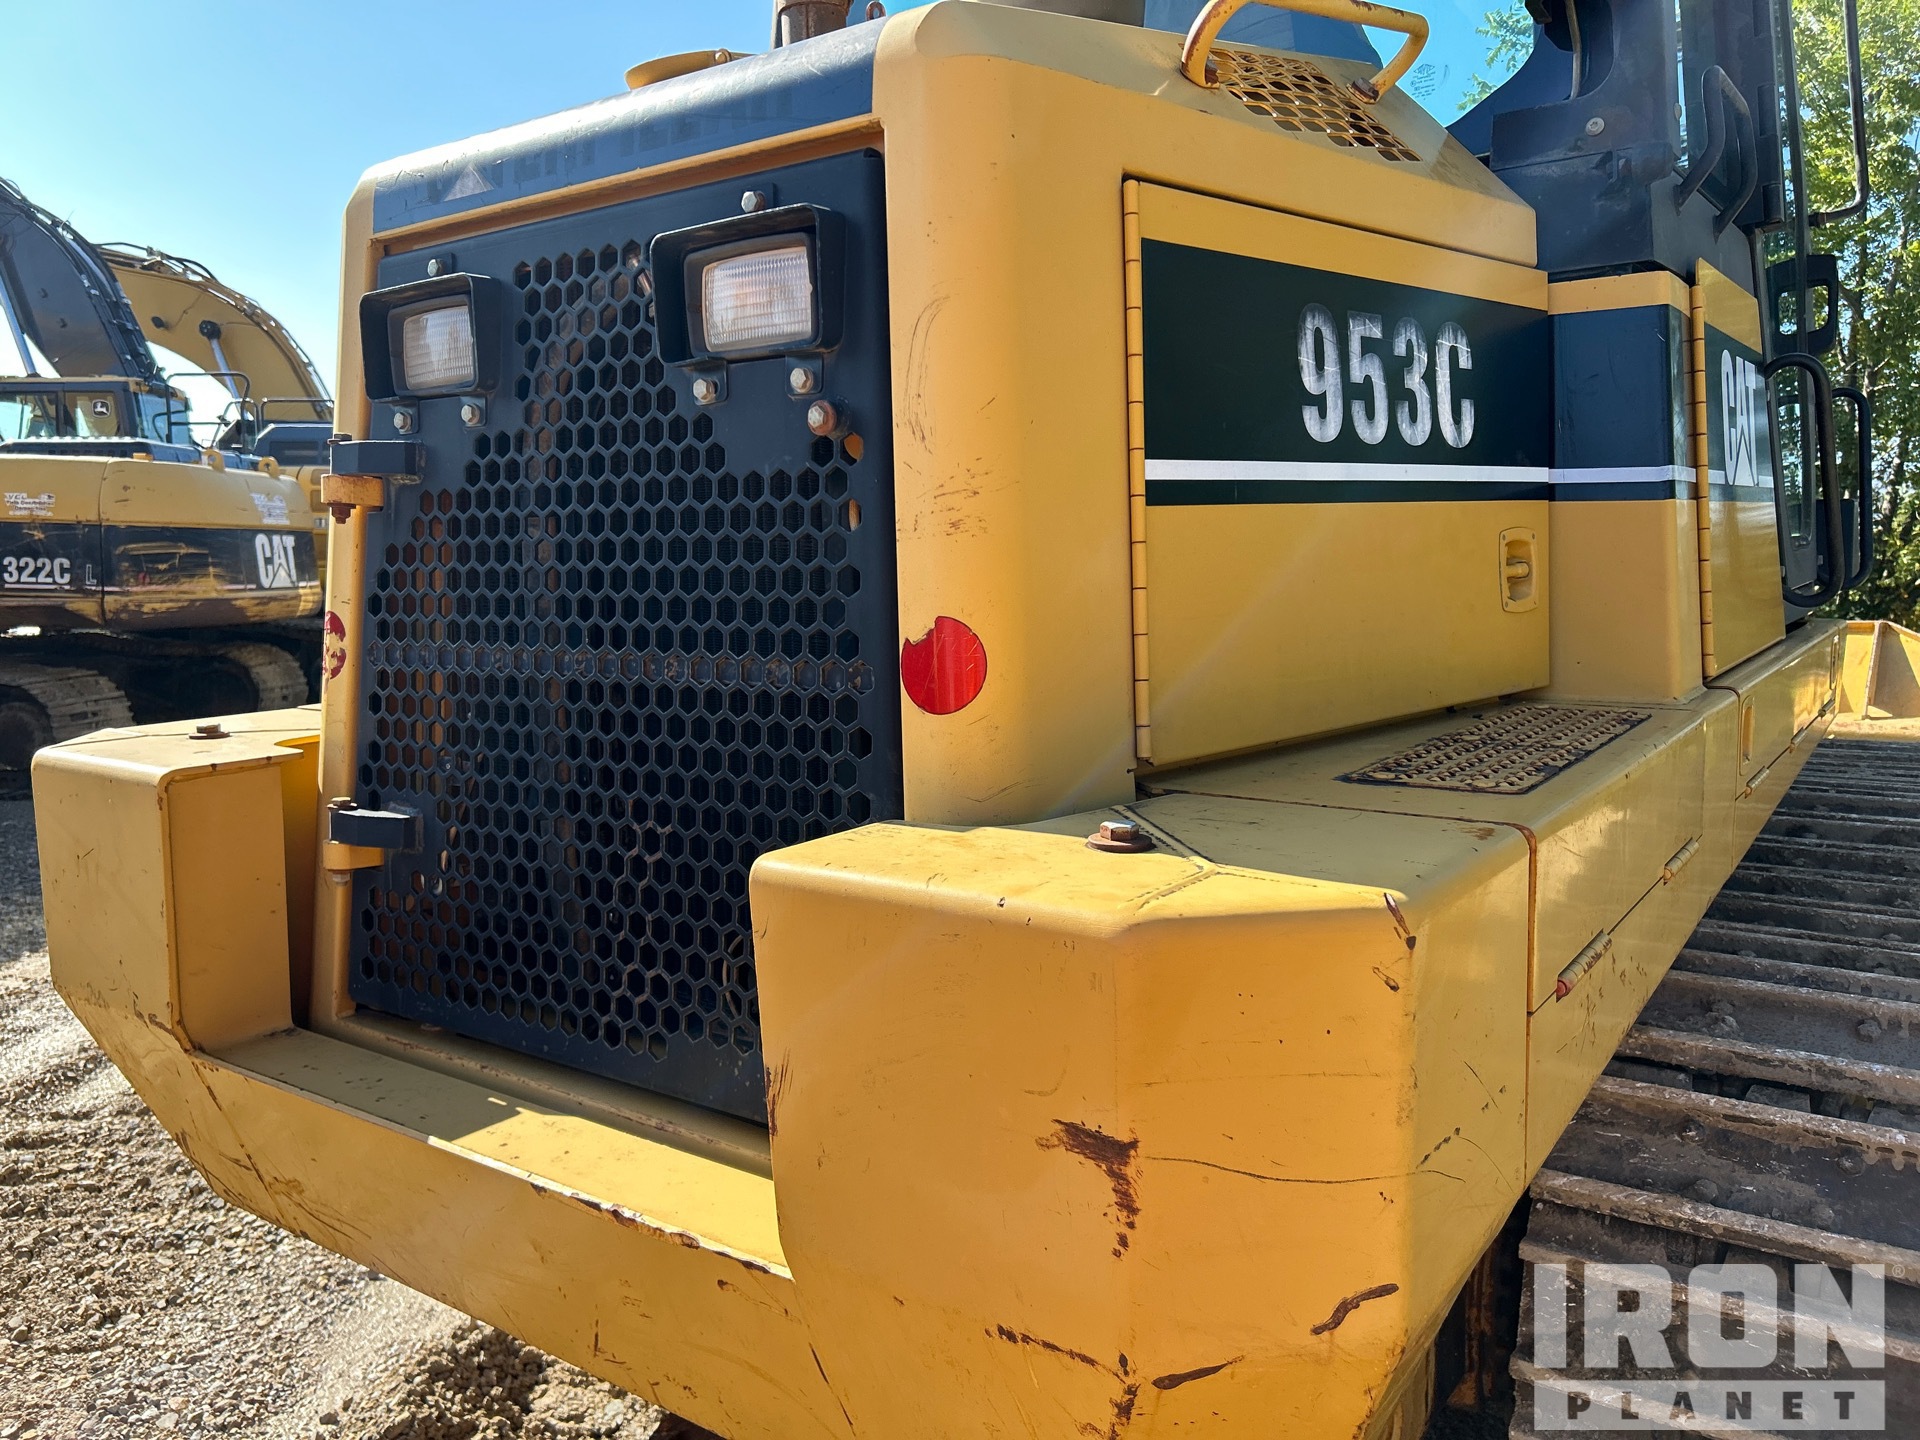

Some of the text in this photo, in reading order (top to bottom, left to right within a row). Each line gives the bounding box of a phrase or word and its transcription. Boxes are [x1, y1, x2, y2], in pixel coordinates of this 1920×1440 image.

[1297, 303, 1475, 448] 953C
[1721, 349, 1758, 486] CAT
[3, 556, 71, 584] 322C
[255, 533, 298, 589] CAT
